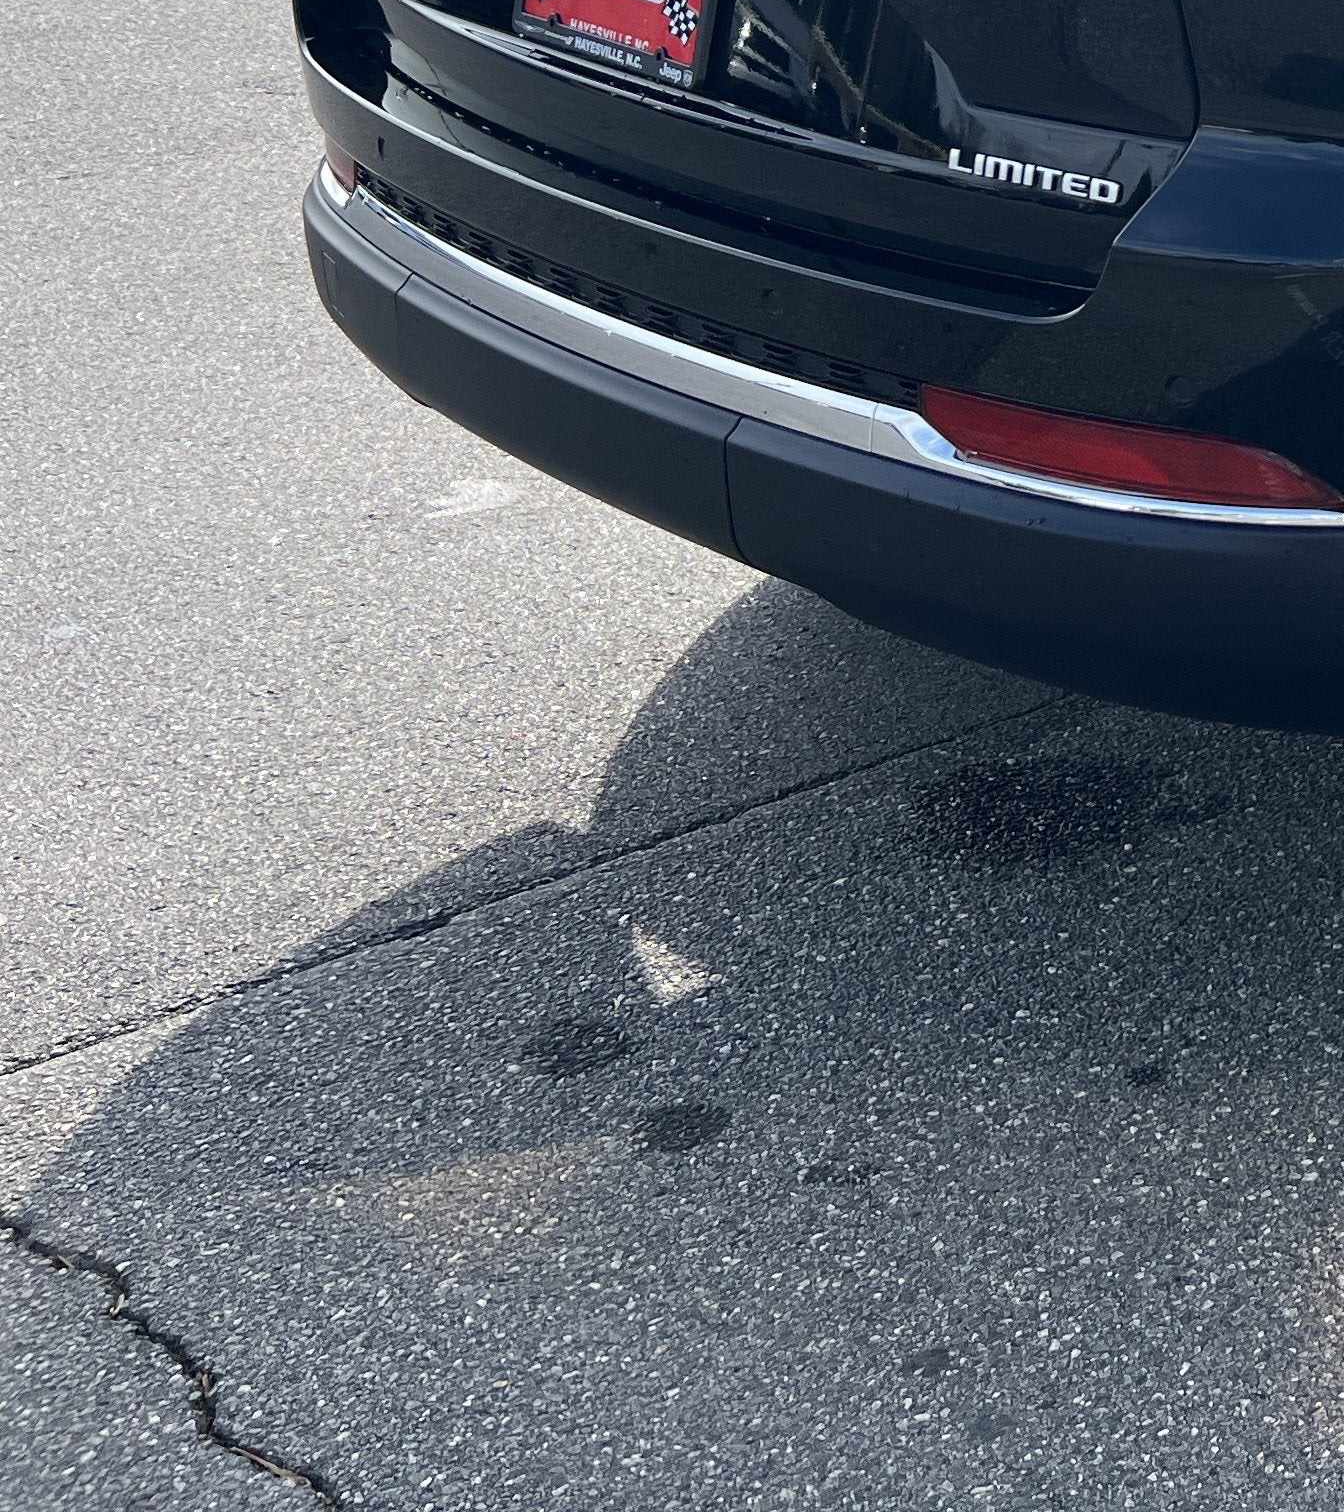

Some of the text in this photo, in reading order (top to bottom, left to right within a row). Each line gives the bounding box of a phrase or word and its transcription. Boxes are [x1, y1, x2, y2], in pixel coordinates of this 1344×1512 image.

[574, 36, 625, 66] HAYESVILLE,
[658, 61, 682, 84] Jeep
[947, 147, 1122, 205] LIMITED
